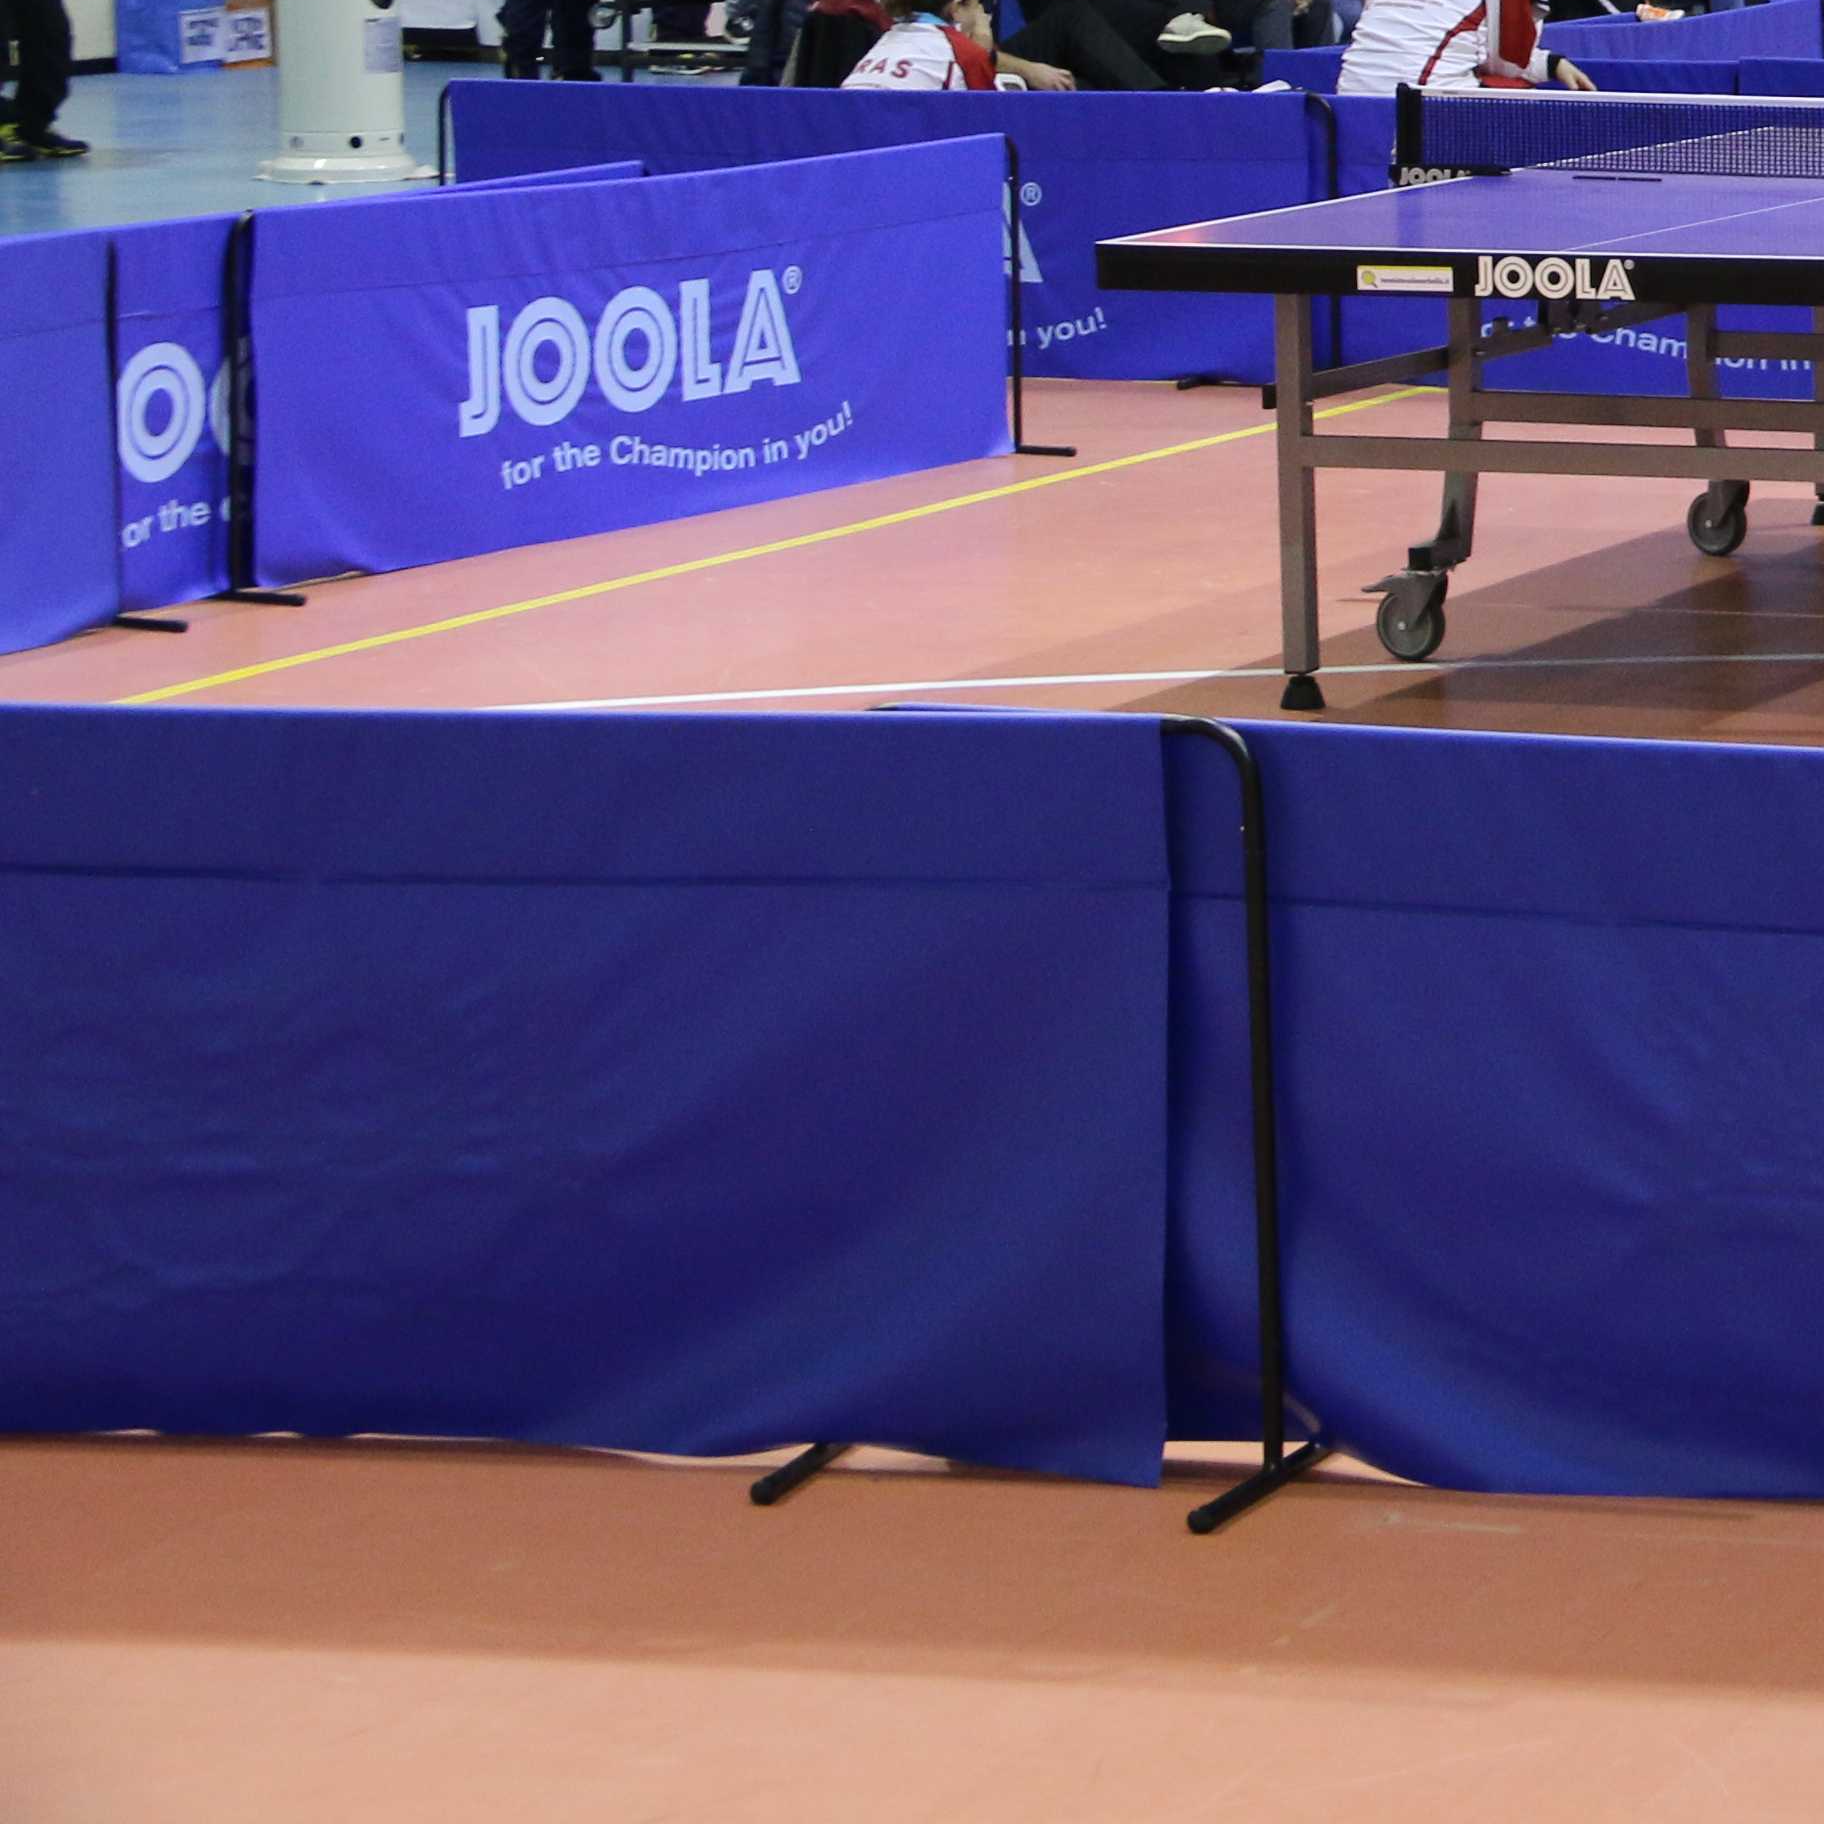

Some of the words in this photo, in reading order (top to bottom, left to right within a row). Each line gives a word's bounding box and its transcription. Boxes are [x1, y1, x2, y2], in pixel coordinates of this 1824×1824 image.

[857, 59, 912, 78] RAS
[1475, 256, 1636, 300] JOOLA
[1038, 306, 1108, 350] you!
[459, 268, 801, 438] JOOLA
[502, 456, 545, 490] for
[553, 441, 601, 472] the
[610, 436, 756, 477] Champion
[762, 437, 789, 464] in
[797, 401, 853, 460] you!
[122, 516, 153, 548] or
[158, 499, 212, 532] the
